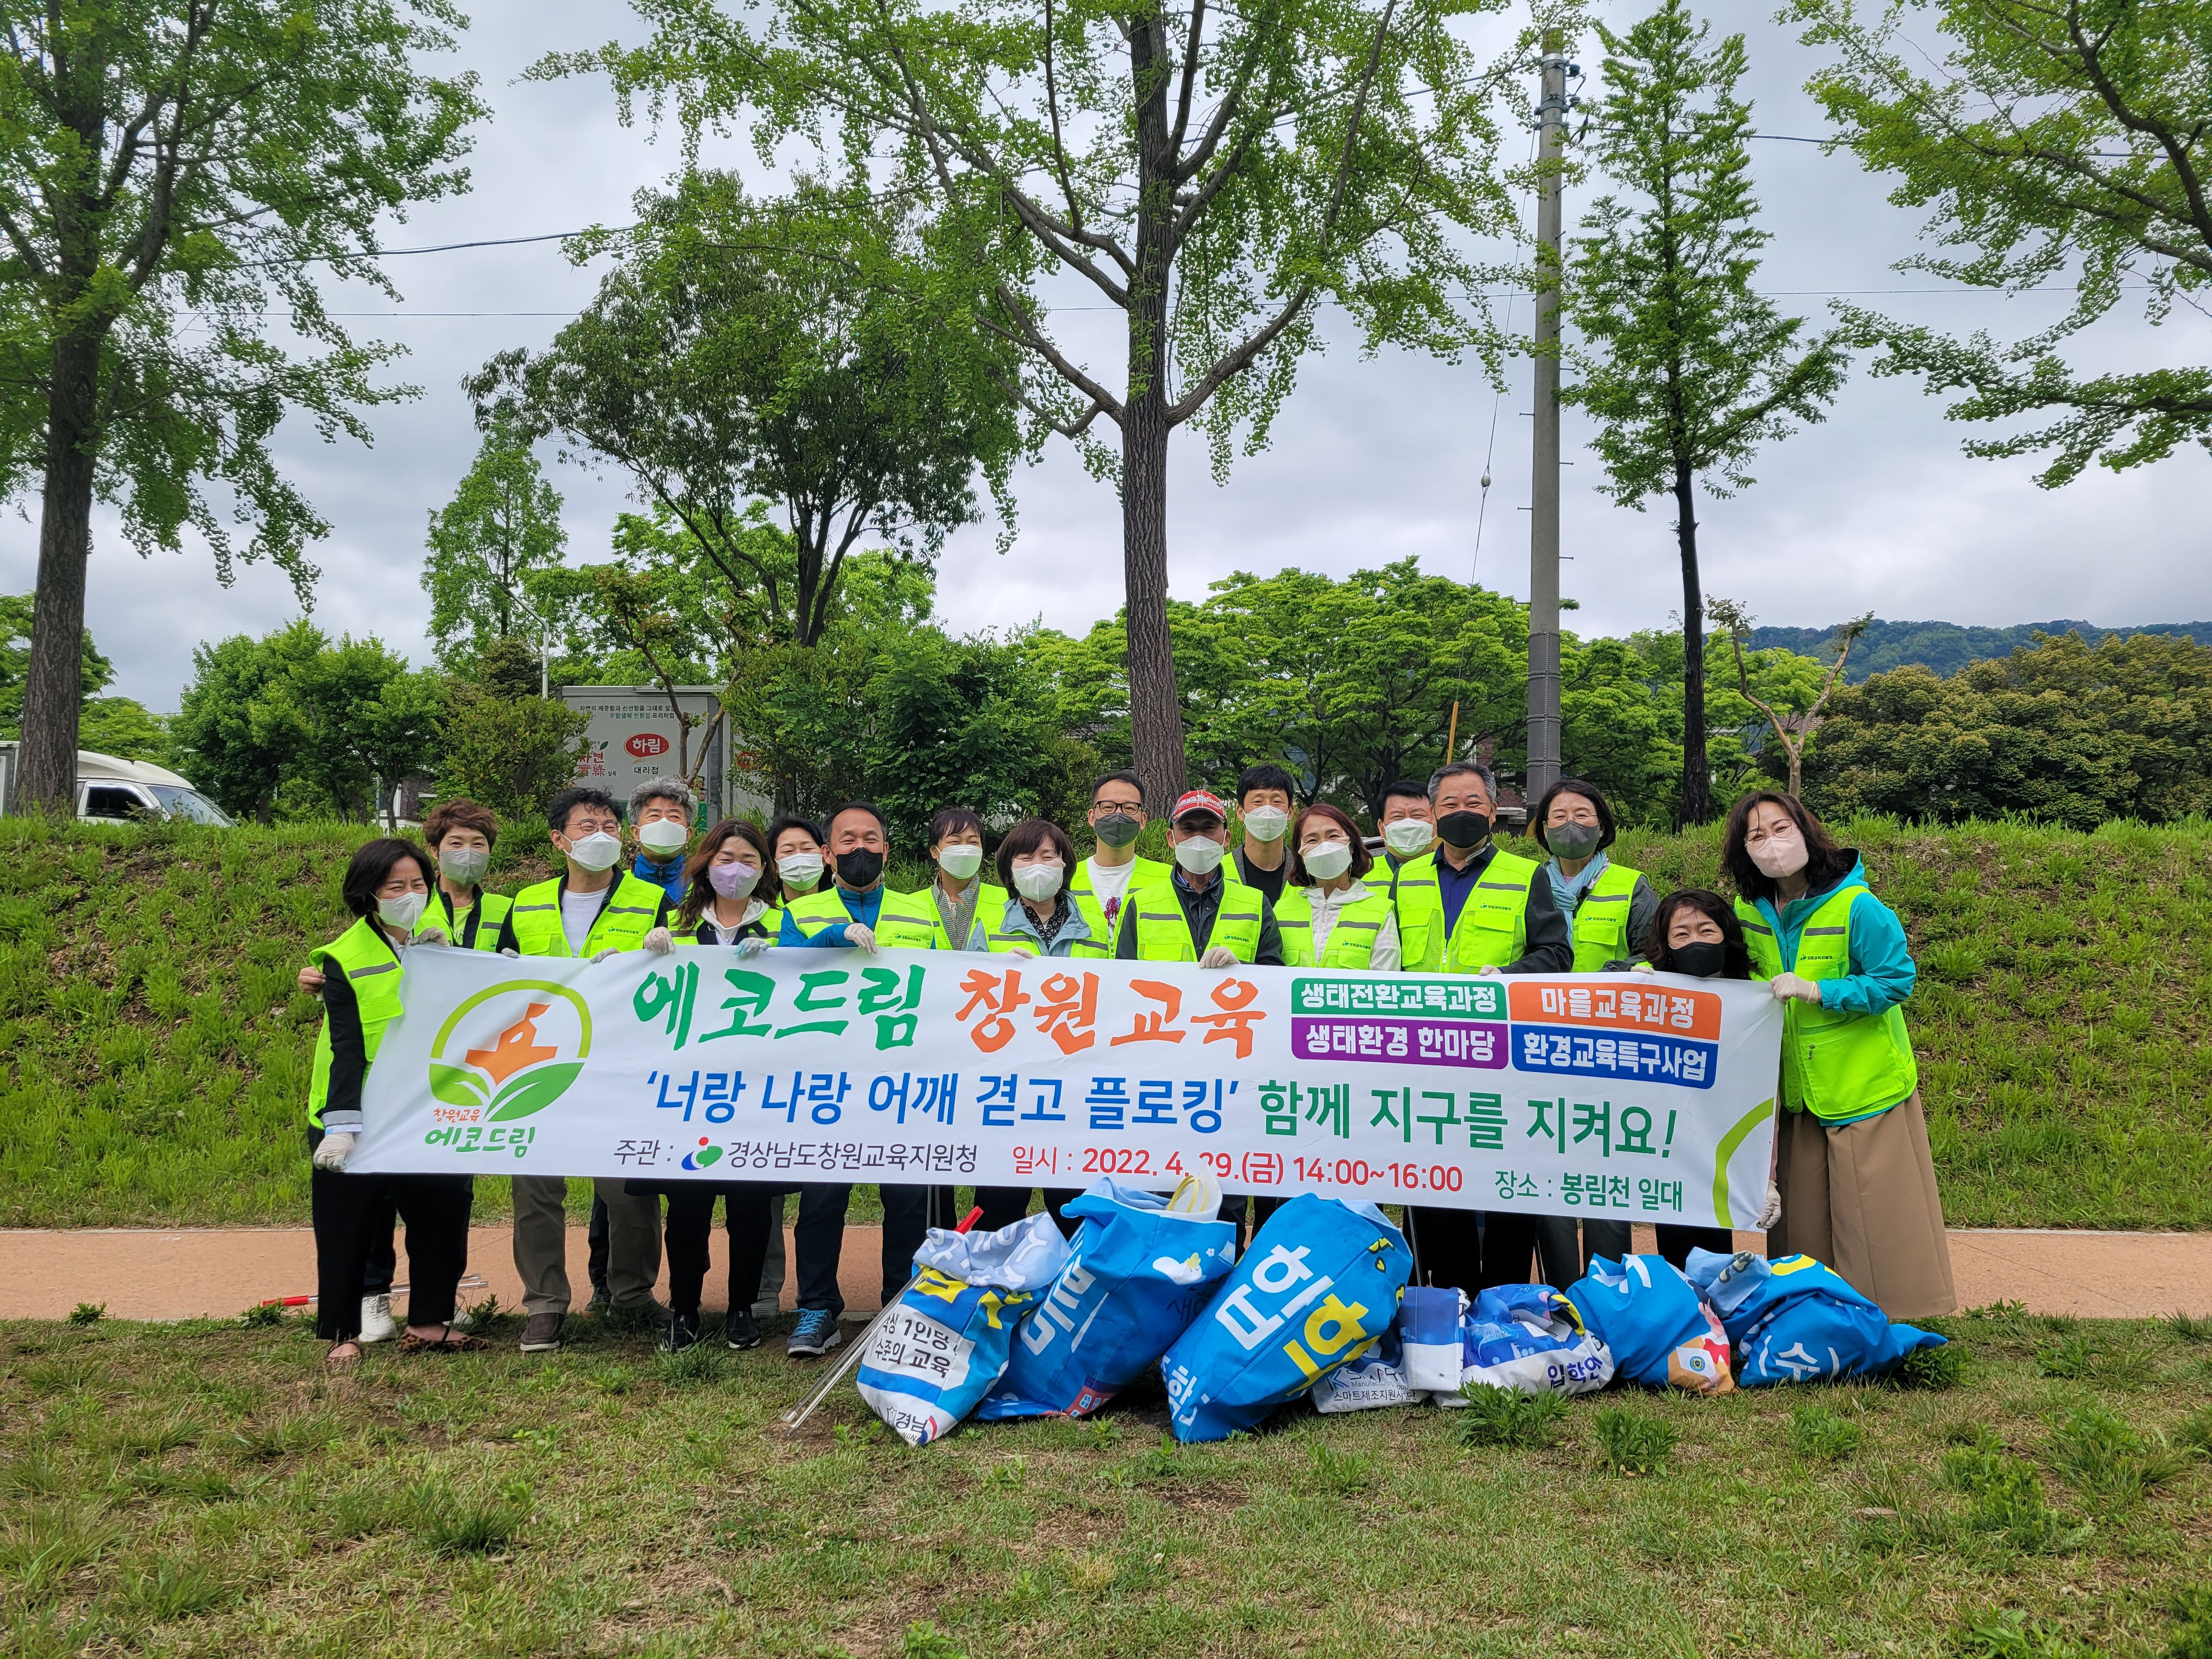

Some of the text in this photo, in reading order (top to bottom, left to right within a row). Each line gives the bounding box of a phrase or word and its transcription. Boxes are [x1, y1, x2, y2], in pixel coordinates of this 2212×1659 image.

[632, 738, 661, 754] 하림
[634, 766, 659, 775] 대리점
[633, 961, 926, 1051] 에코드림
[1300, 983, 1498, 1013] 생태전환교육과정
[1541, 988, 1695, 1029] 마을교육과정
[1307, 1027, 1496, 1062] 생태환경 한마당
[1523, 1033, 1707, 1081] 환경교육특구사업
[433, 1108, 480, 1124] 창원교육
[761, 1071, 851, 1124] 나랑
[868, 1072, 958, 1125] 어깨
[1260, 1079, 1350, 1139] 함께
[1370, 1086, 1509, 1150] 지구를
[1526, 1097, 1677, 1158] 지켜요!
[425, 1126, 536, 1159] 에코드림
[727, 1141, 977, 1173] 경상남도창원교육지원청
[1012, 1146, 1057, 1175] 일시
[1082, 1148, 1158, 1176] 2022.
[1166, 1152, 1189, 1176] 4.
[1294, 1156, 1463, 1192] 14:00~16:00
[1494, 1170, 1539, 1200] 장소
[1560, 1172, 1630, 1207] 봉림천
[1638, 1177, 1683, 1212] 일대
[904, 1319, 949, 1350] 1인당
[909, 1348, 951, 1379] 교육
